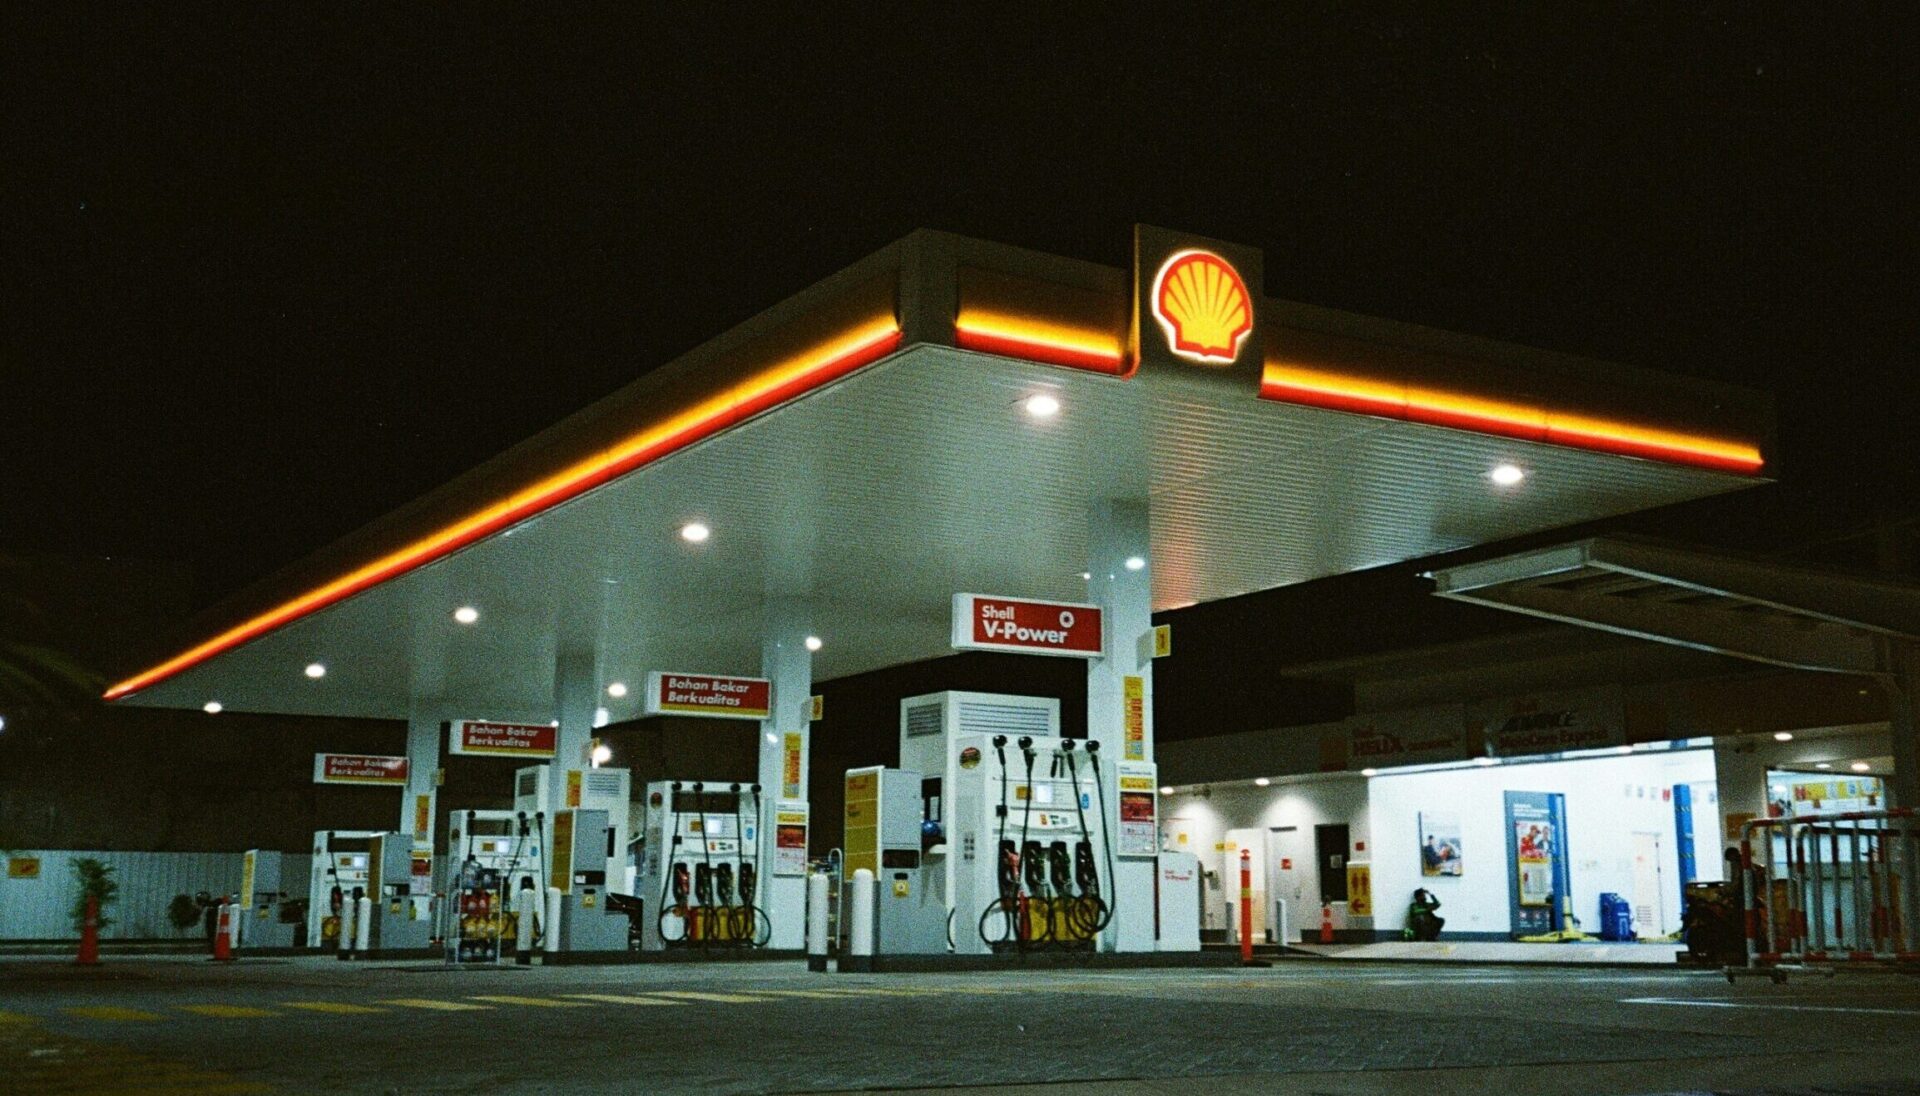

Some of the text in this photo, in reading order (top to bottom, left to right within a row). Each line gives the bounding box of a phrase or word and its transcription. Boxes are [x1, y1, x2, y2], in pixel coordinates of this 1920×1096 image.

[982, 605, 1014, 620] Shell
[982, 620, 1068, 644] V-Power
[668, 677, 749, 693] Bahan Bakar
[667, 691, 741, 706] Berkualitas
[469, 725, 539, 737] Bahan Bakar
[468, 736, 530, 747] Berkualitas
